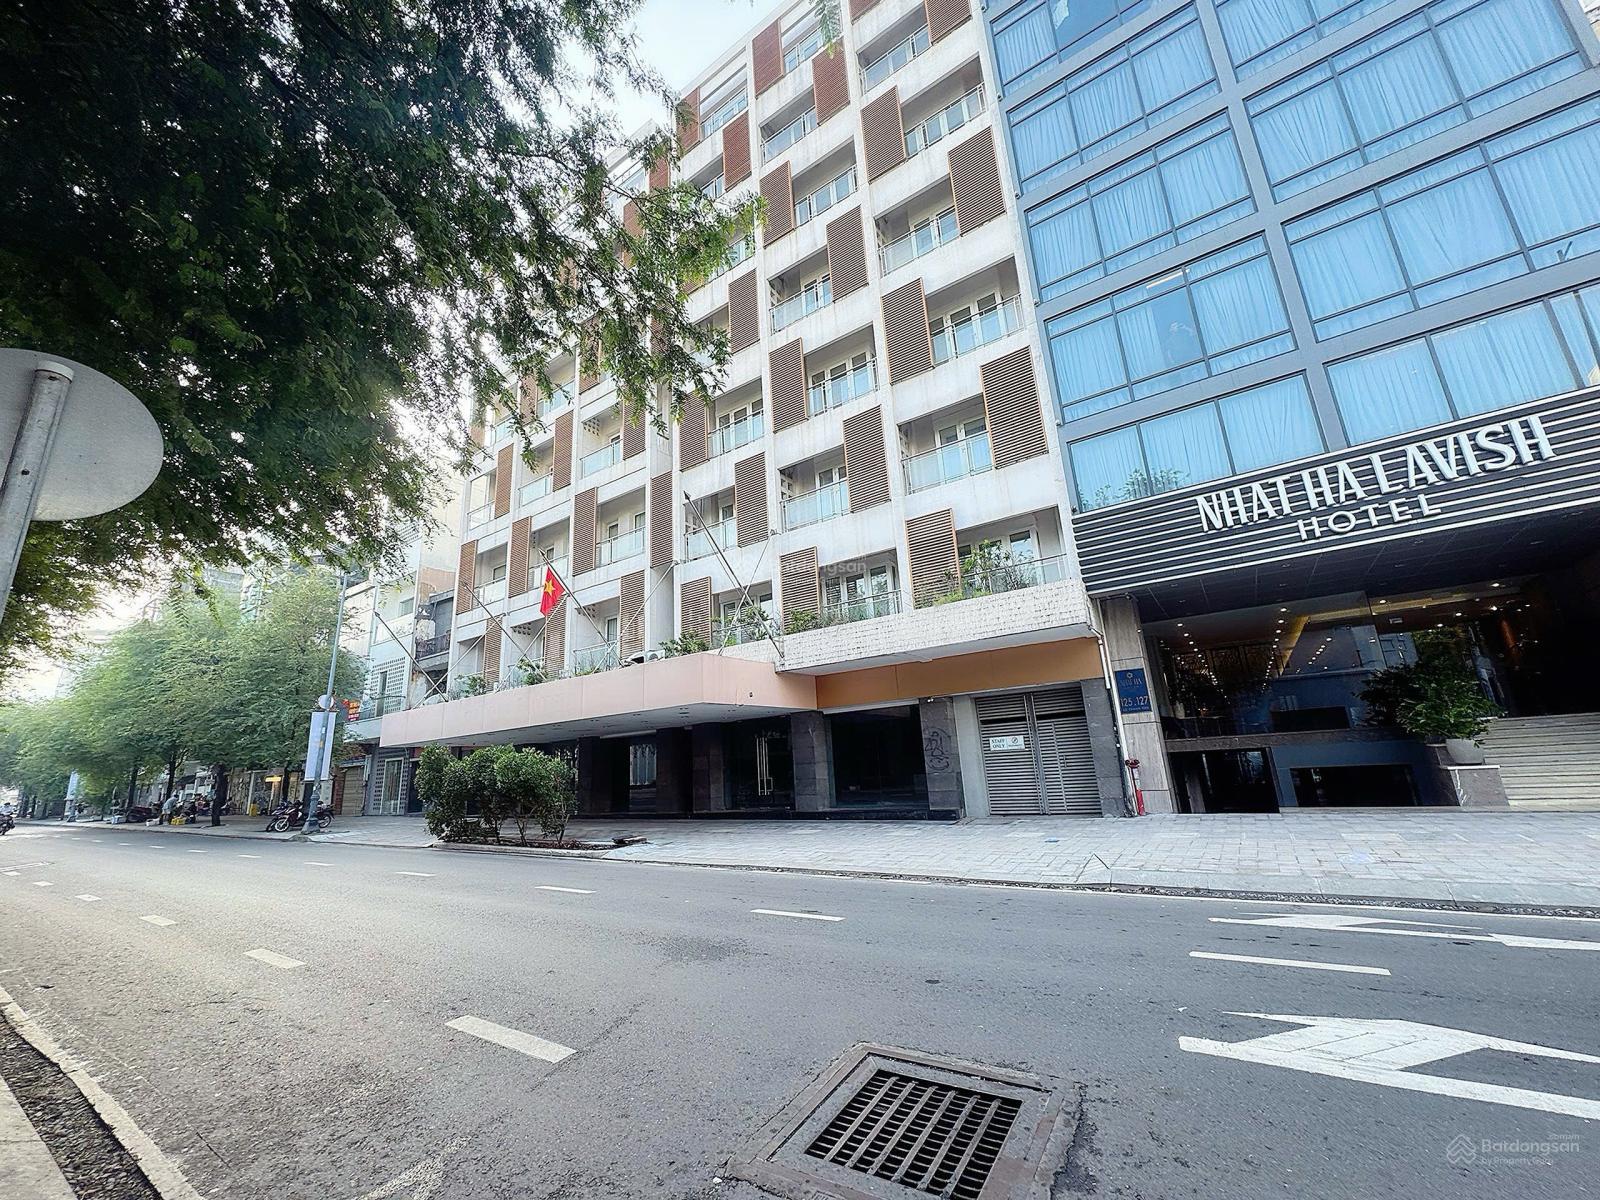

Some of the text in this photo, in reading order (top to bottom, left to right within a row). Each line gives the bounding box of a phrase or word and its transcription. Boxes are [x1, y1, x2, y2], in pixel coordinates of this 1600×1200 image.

[1195, 414, 1557, 532] NHAT HA LAVISH
[1297, 493, 1442, 541] HOTEL
